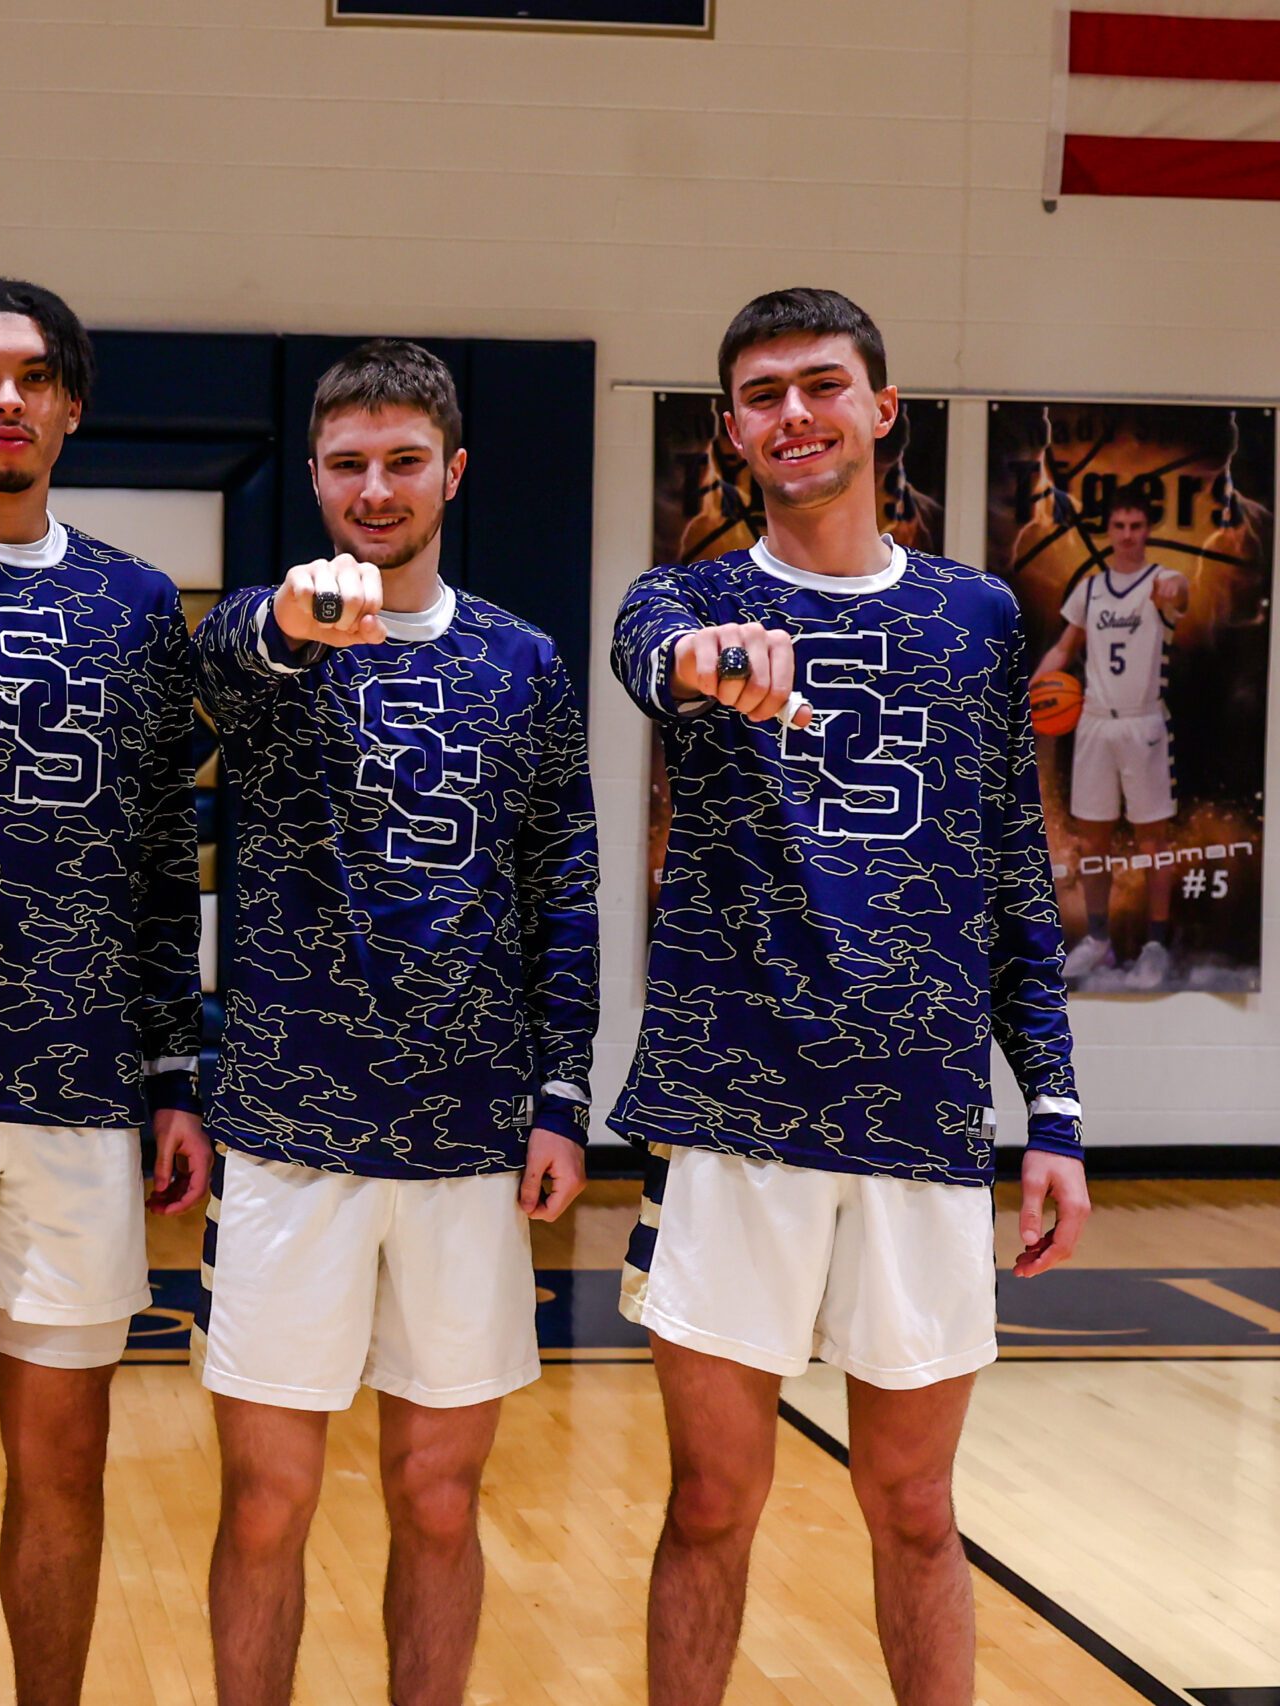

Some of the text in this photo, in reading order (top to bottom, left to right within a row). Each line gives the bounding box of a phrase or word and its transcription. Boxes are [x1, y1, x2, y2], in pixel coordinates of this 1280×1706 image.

[1096, 609, 1142, 635] Shady
[1110, 642, 1126, 675] 5
[1080, 841, 1253, 876] Chapman
[1182, 869, 1229, 899] #5
